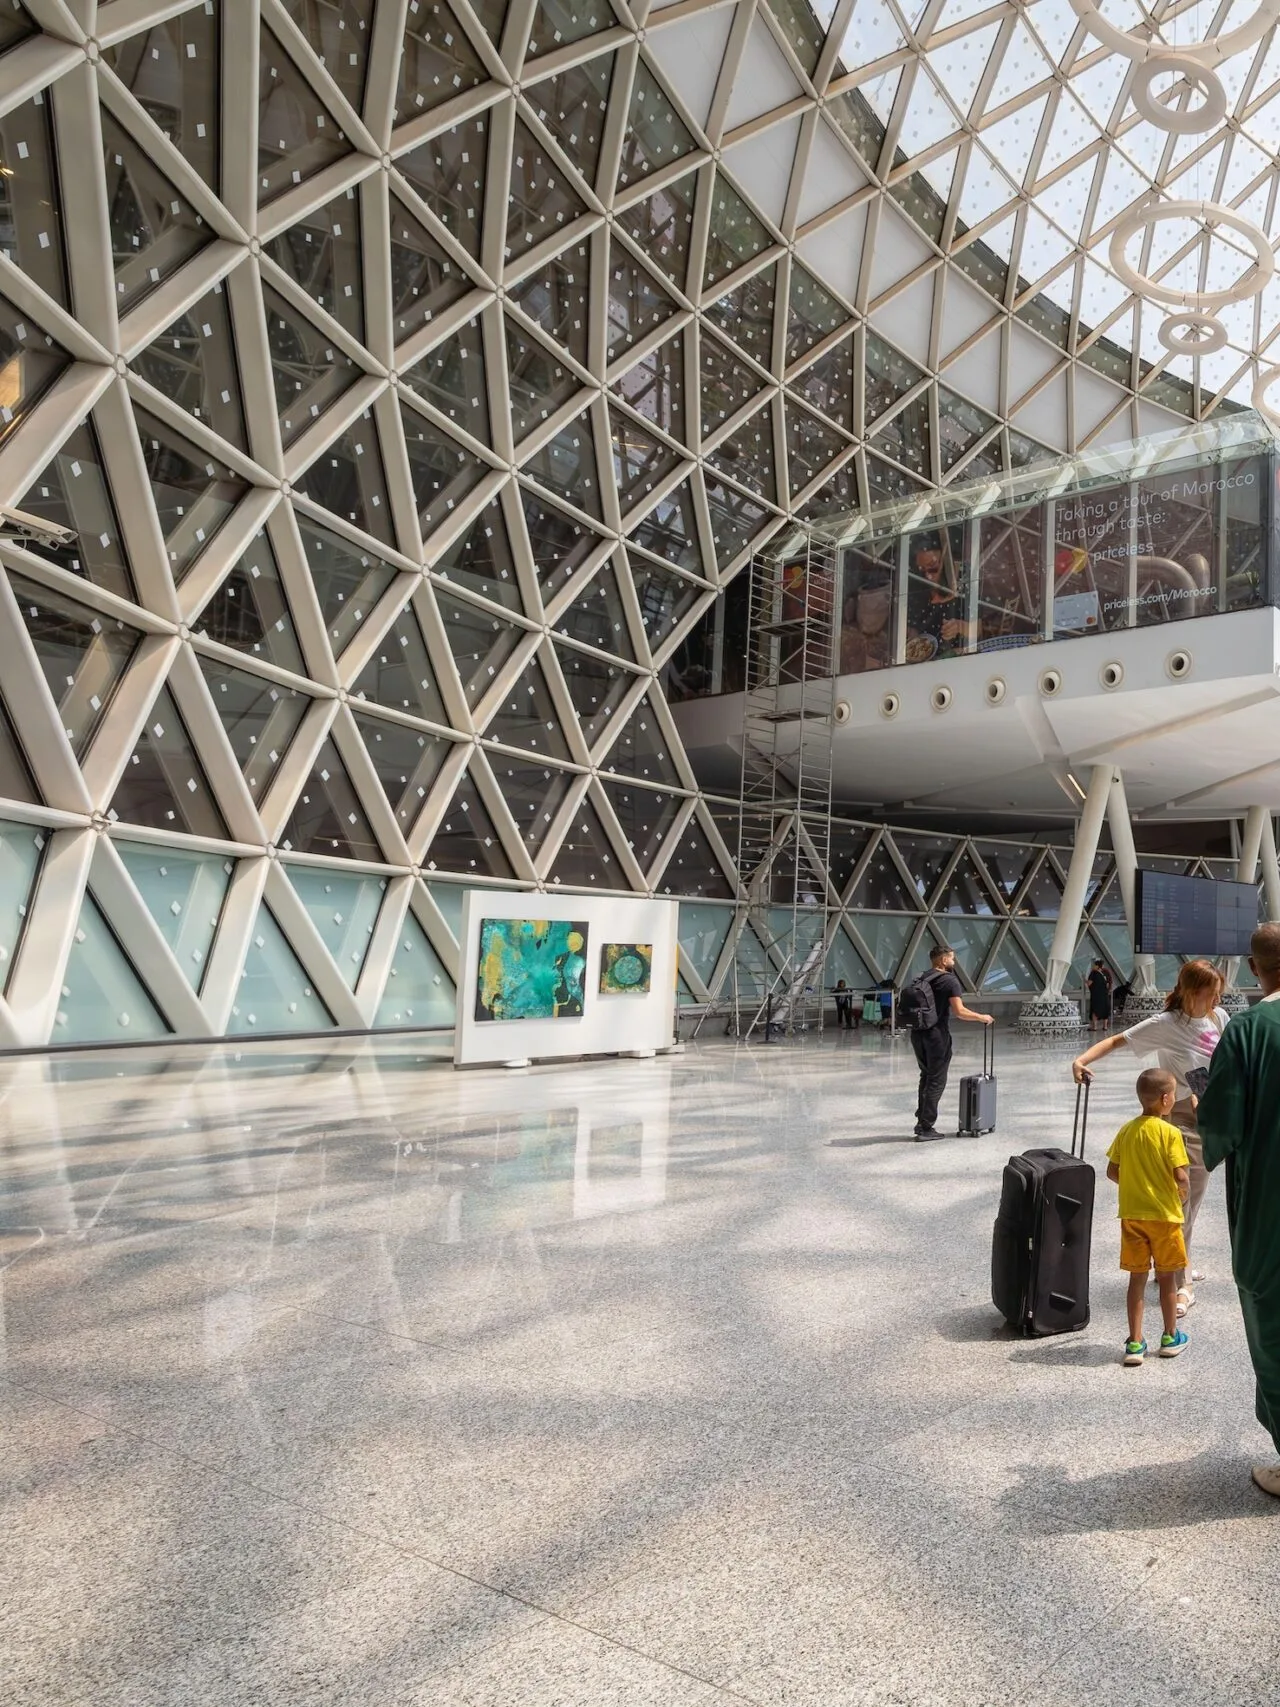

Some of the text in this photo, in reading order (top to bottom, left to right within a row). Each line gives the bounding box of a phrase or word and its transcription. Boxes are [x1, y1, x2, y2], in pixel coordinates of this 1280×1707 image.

[1056, 473, 1255, 522] Taking a tour of Morocco
[1056, 520, 1116, 542] through
[1093, 542, 1154, 565] priceless
[1103, 585, 1218, 613] priceless.com/Morocco
